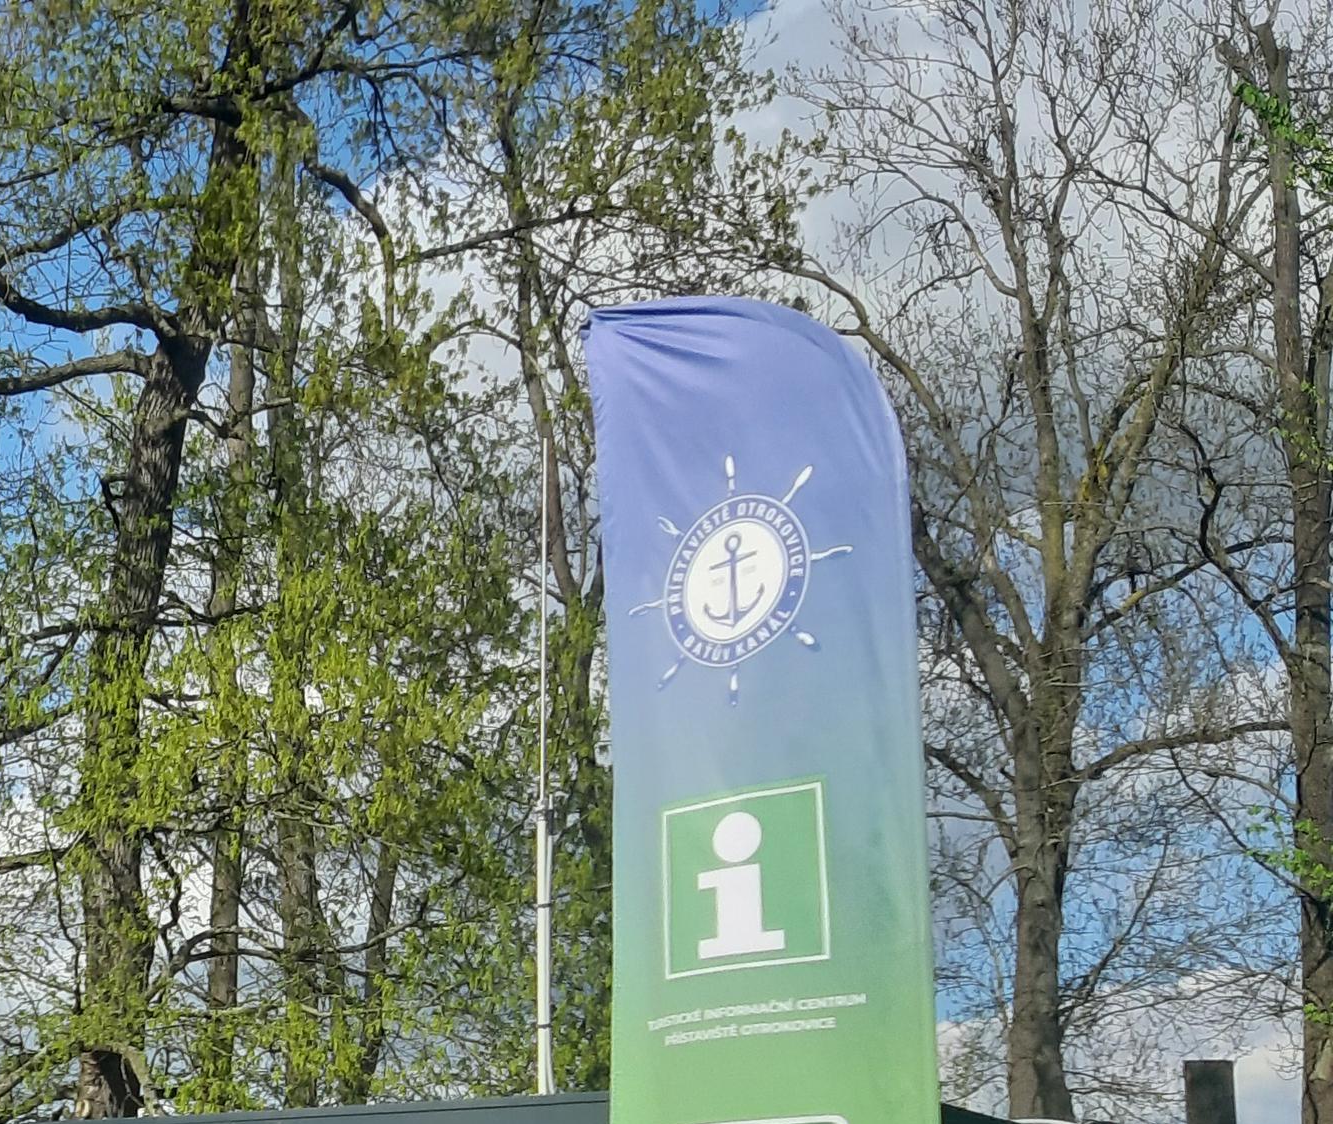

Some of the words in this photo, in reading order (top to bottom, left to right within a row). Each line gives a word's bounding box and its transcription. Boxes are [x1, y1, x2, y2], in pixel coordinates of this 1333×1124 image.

[737, 502, 804, 577] OTROKOVICE
[735, 610, 791, 656] KANÁL
[796, 993, 867, 1011] CENTRUM
[740, 1017, 837, 1037] OTROKOVICE
